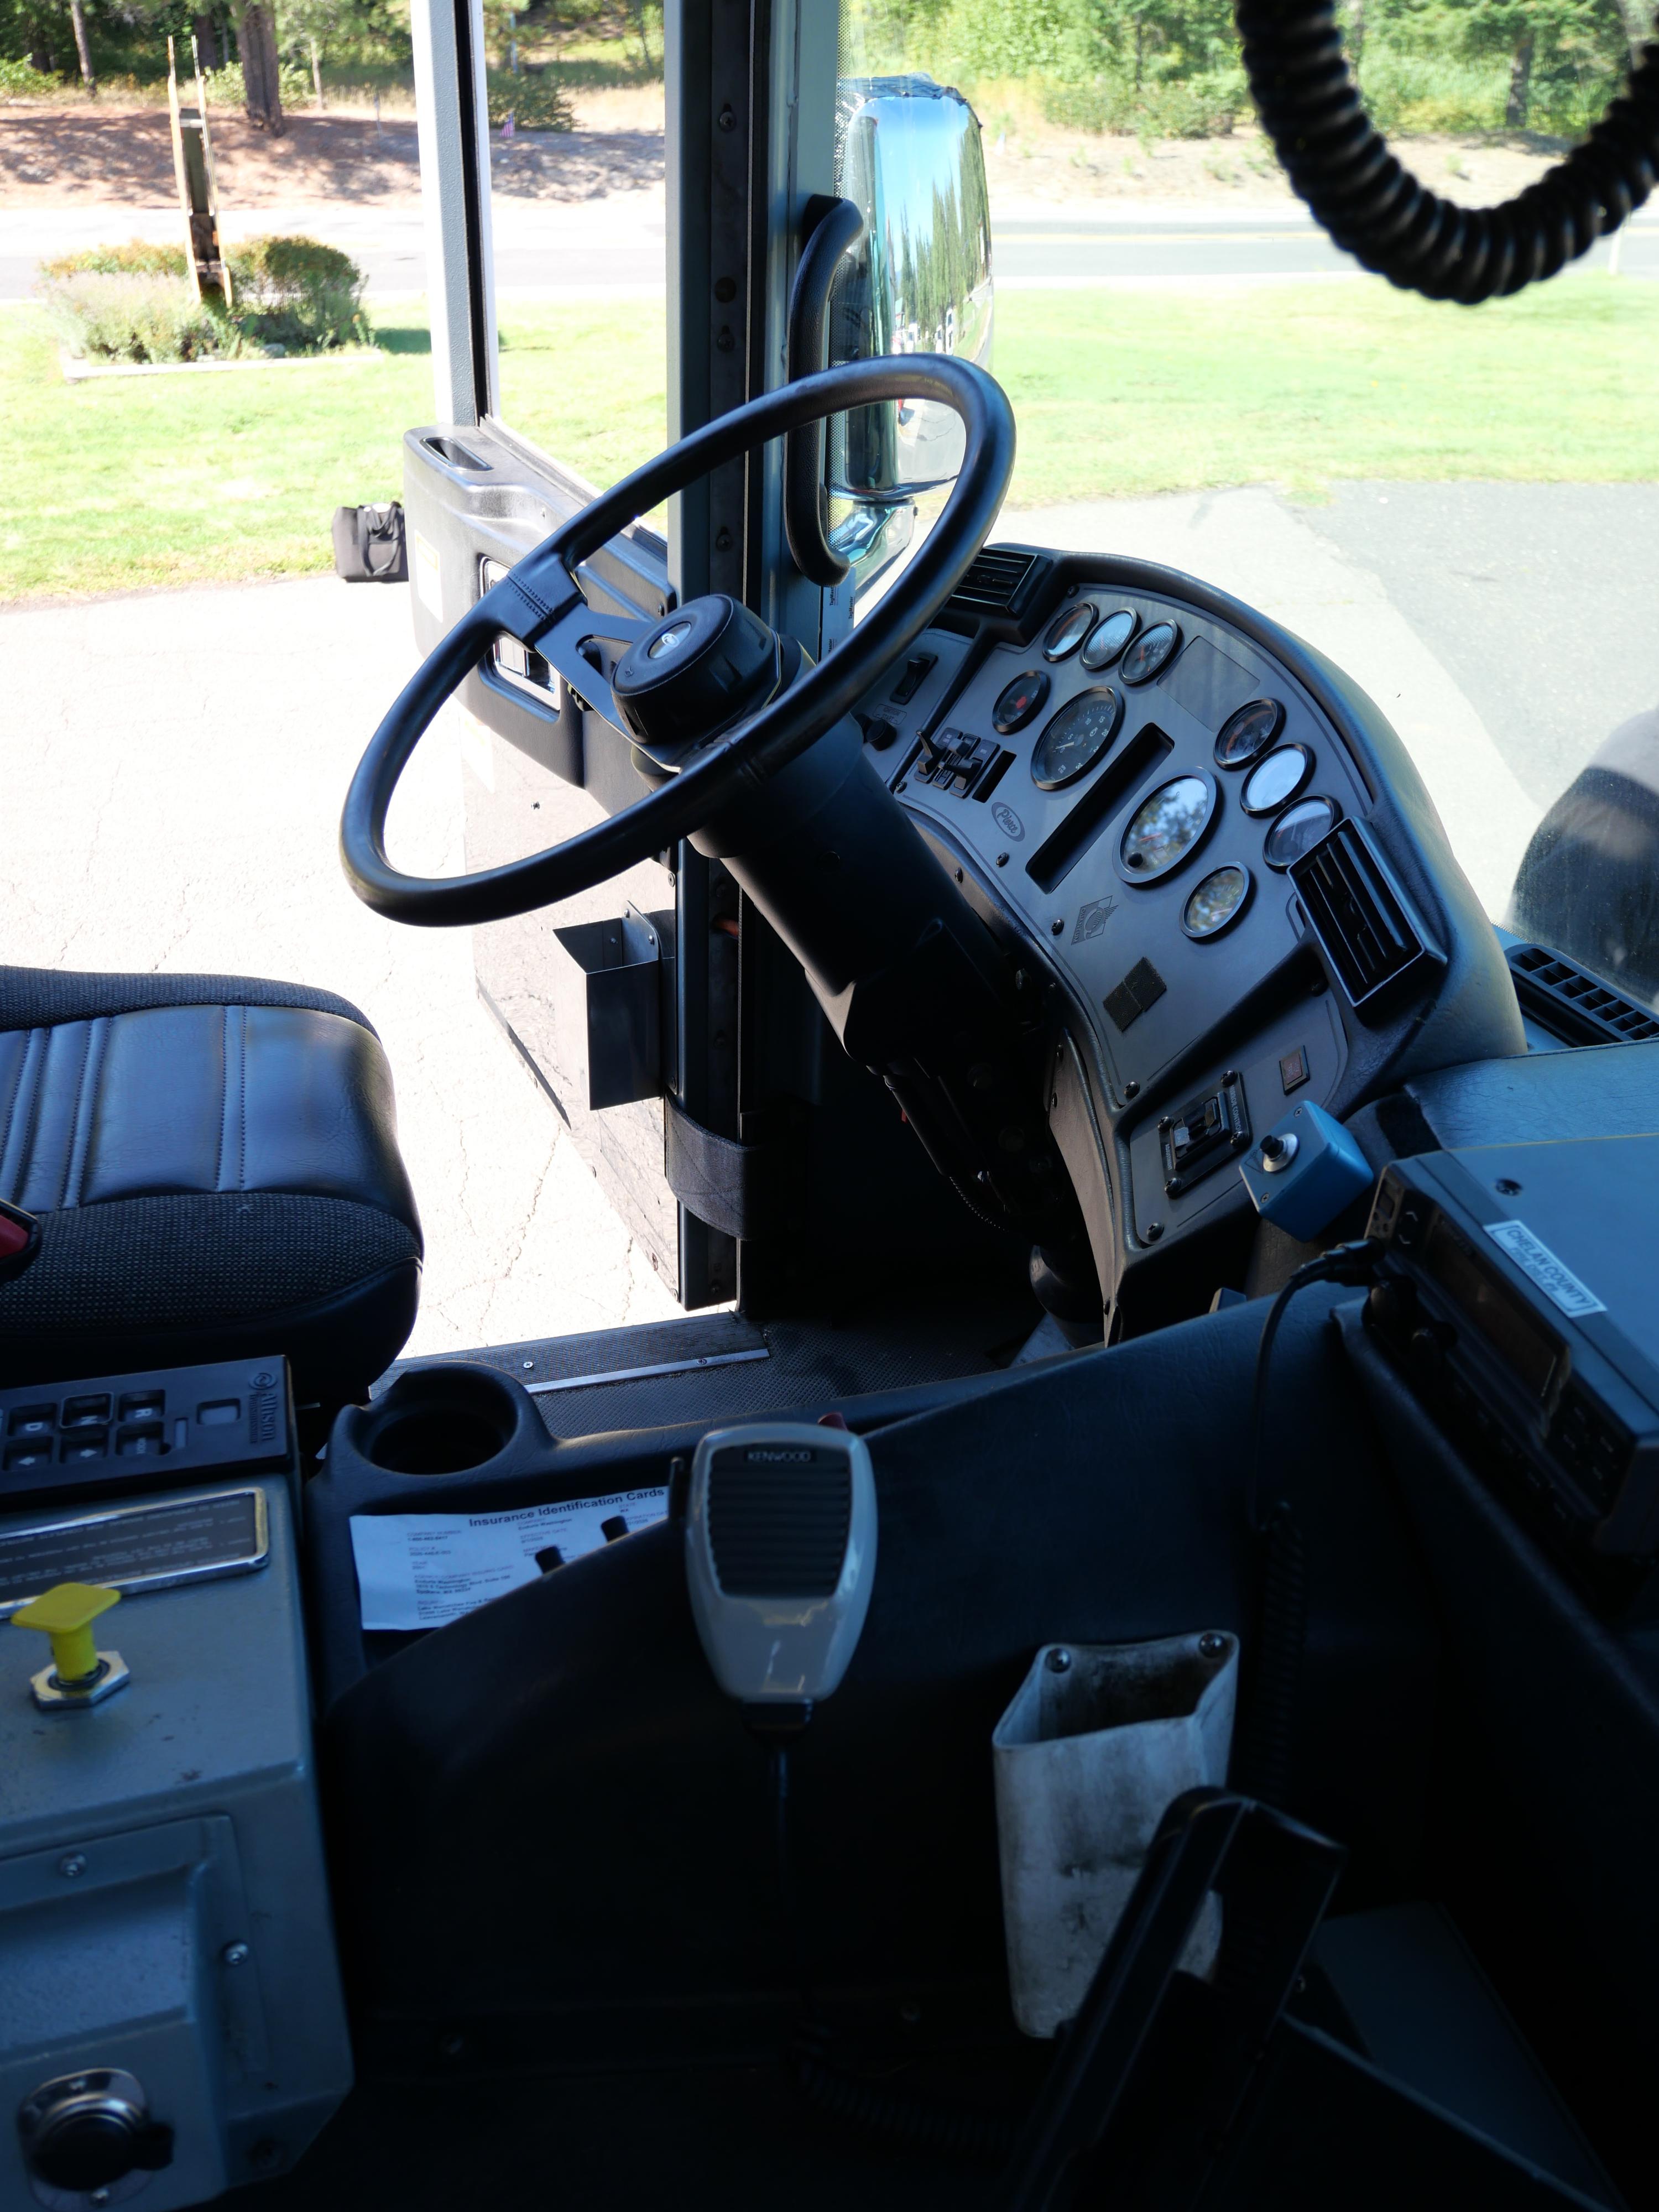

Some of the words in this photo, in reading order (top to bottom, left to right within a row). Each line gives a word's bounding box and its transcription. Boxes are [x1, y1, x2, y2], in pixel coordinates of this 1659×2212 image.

[997, 808, 1018, 833] Pierce
[1073, 907, 1086, 943] QUANTUM
[1507, 1229, 1549, 1266] CHELAN
[1544, 1266, 1590, 1304] COUNTY
[25, 1422, 44, 1432] D
[135, 1407, 153, 1418] R
[262, 1393, 277, 1441] Allison
[747, 1451, 812, 1463] KENWOOD
[469, 1511, 535, 1527] Insurance
[539, 1495, 623, 1516] Identification
[626, 1489, 664, 1501] Cards
